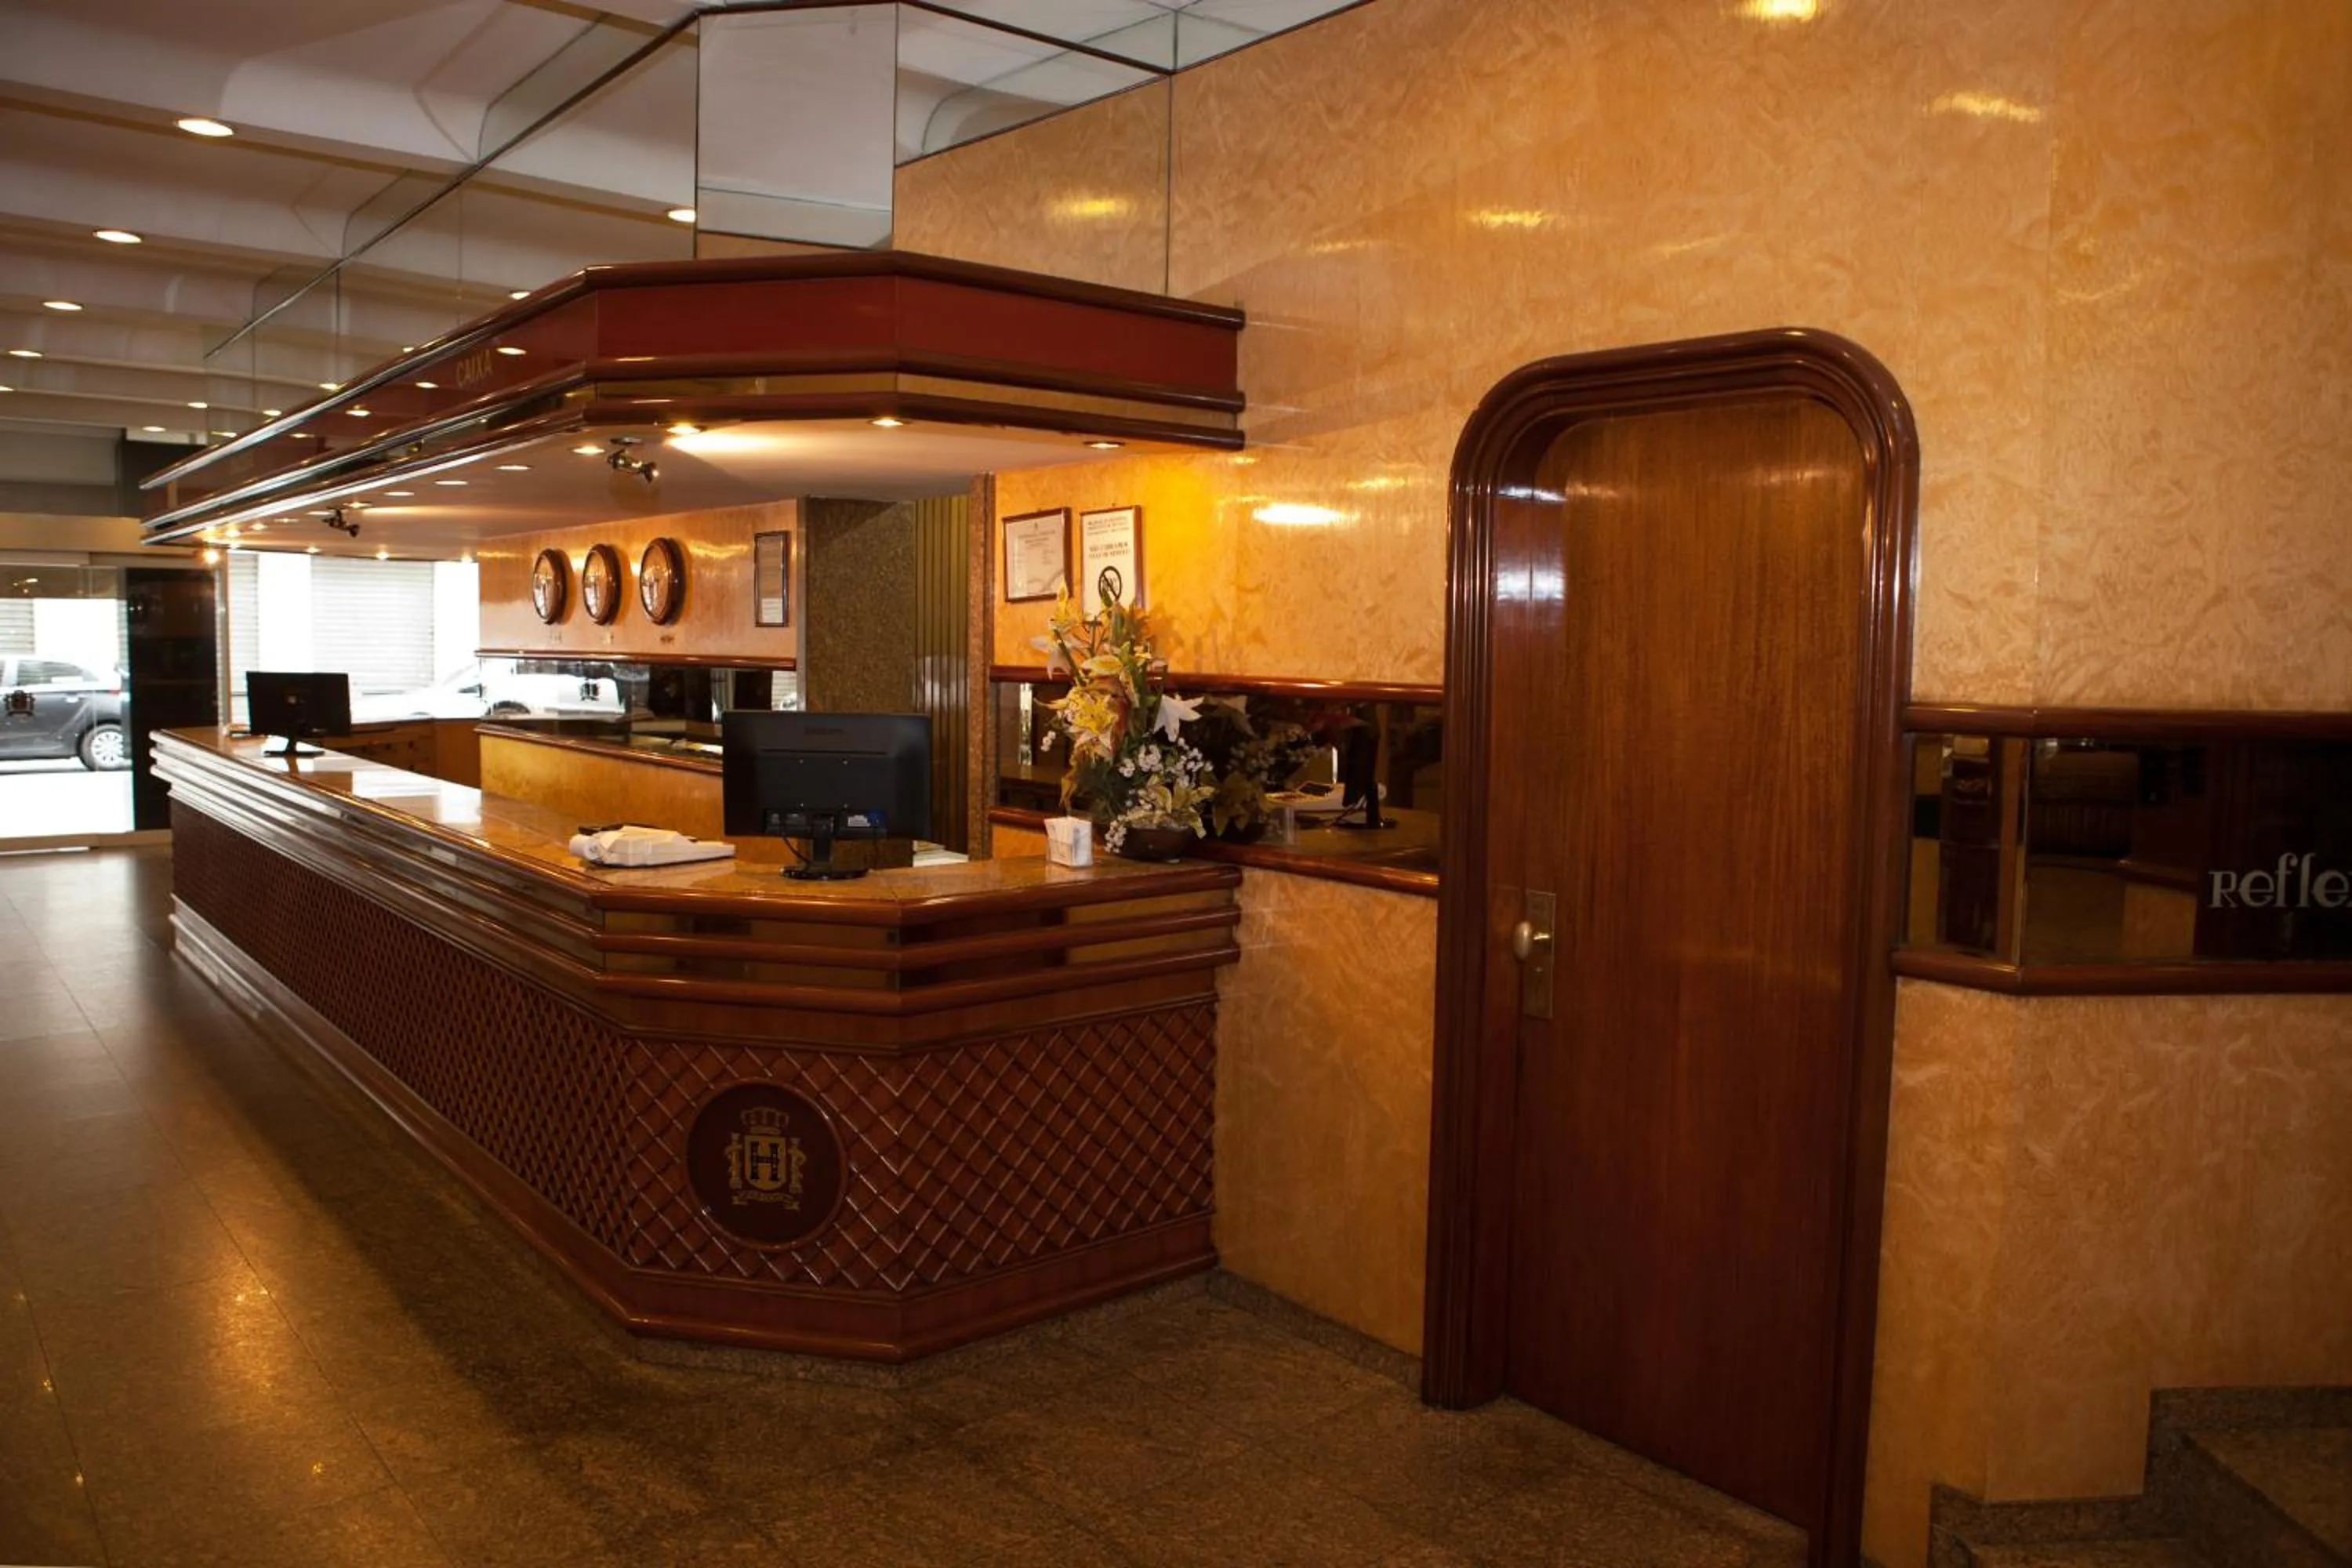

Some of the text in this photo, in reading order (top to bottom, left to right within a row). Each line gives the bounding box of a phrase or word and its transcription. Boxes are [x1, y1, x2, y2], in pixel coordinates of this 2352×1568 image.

[456, 349, 493, 388] CAIXA
[2208, 852, 2352, 908] Refle
[750, 1141, 781, 1181] H
